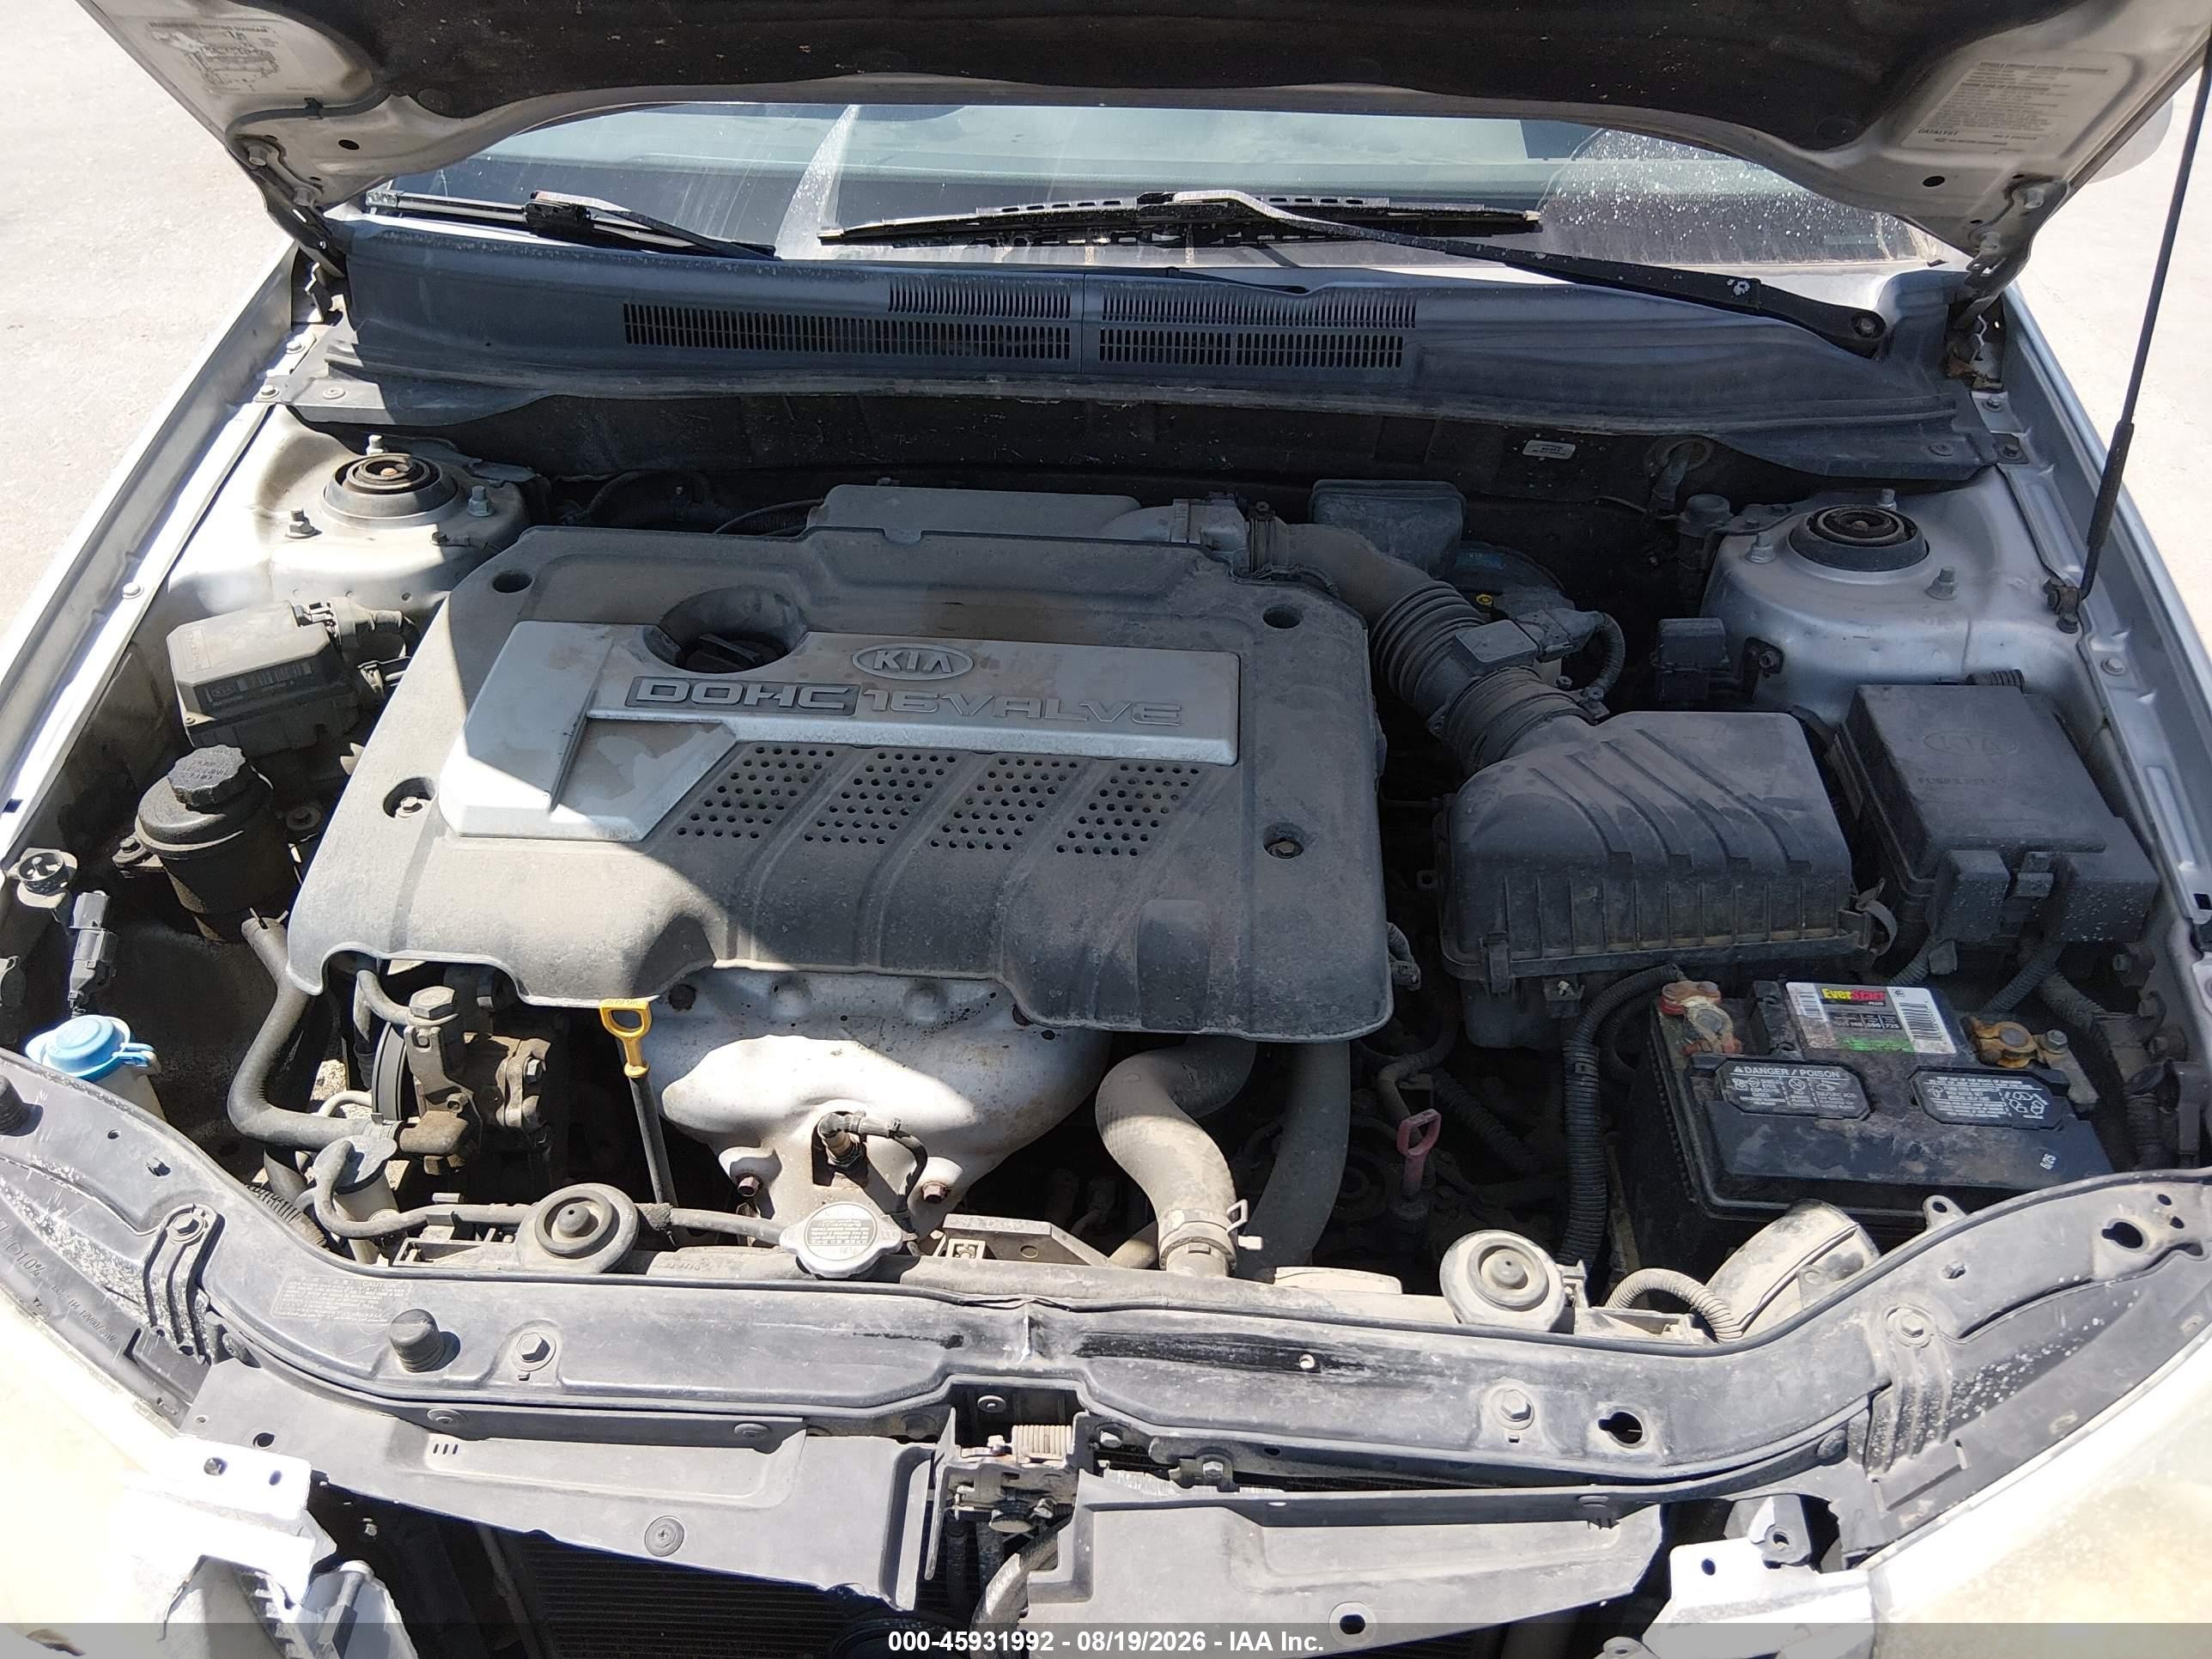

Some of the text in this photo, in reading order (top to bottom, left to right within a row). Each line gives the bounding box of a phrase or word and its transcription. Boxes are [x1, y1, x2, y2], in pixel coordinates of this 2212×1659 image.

[872, 650, 954, 674] KIA
[636, 678, 851, 709] DOHC
[1820, 987, 1887, 1002] EverStart
[1743, 1066, 1789, 1076] DANGER
[1800, 1070, 1840, 1079] POISON
